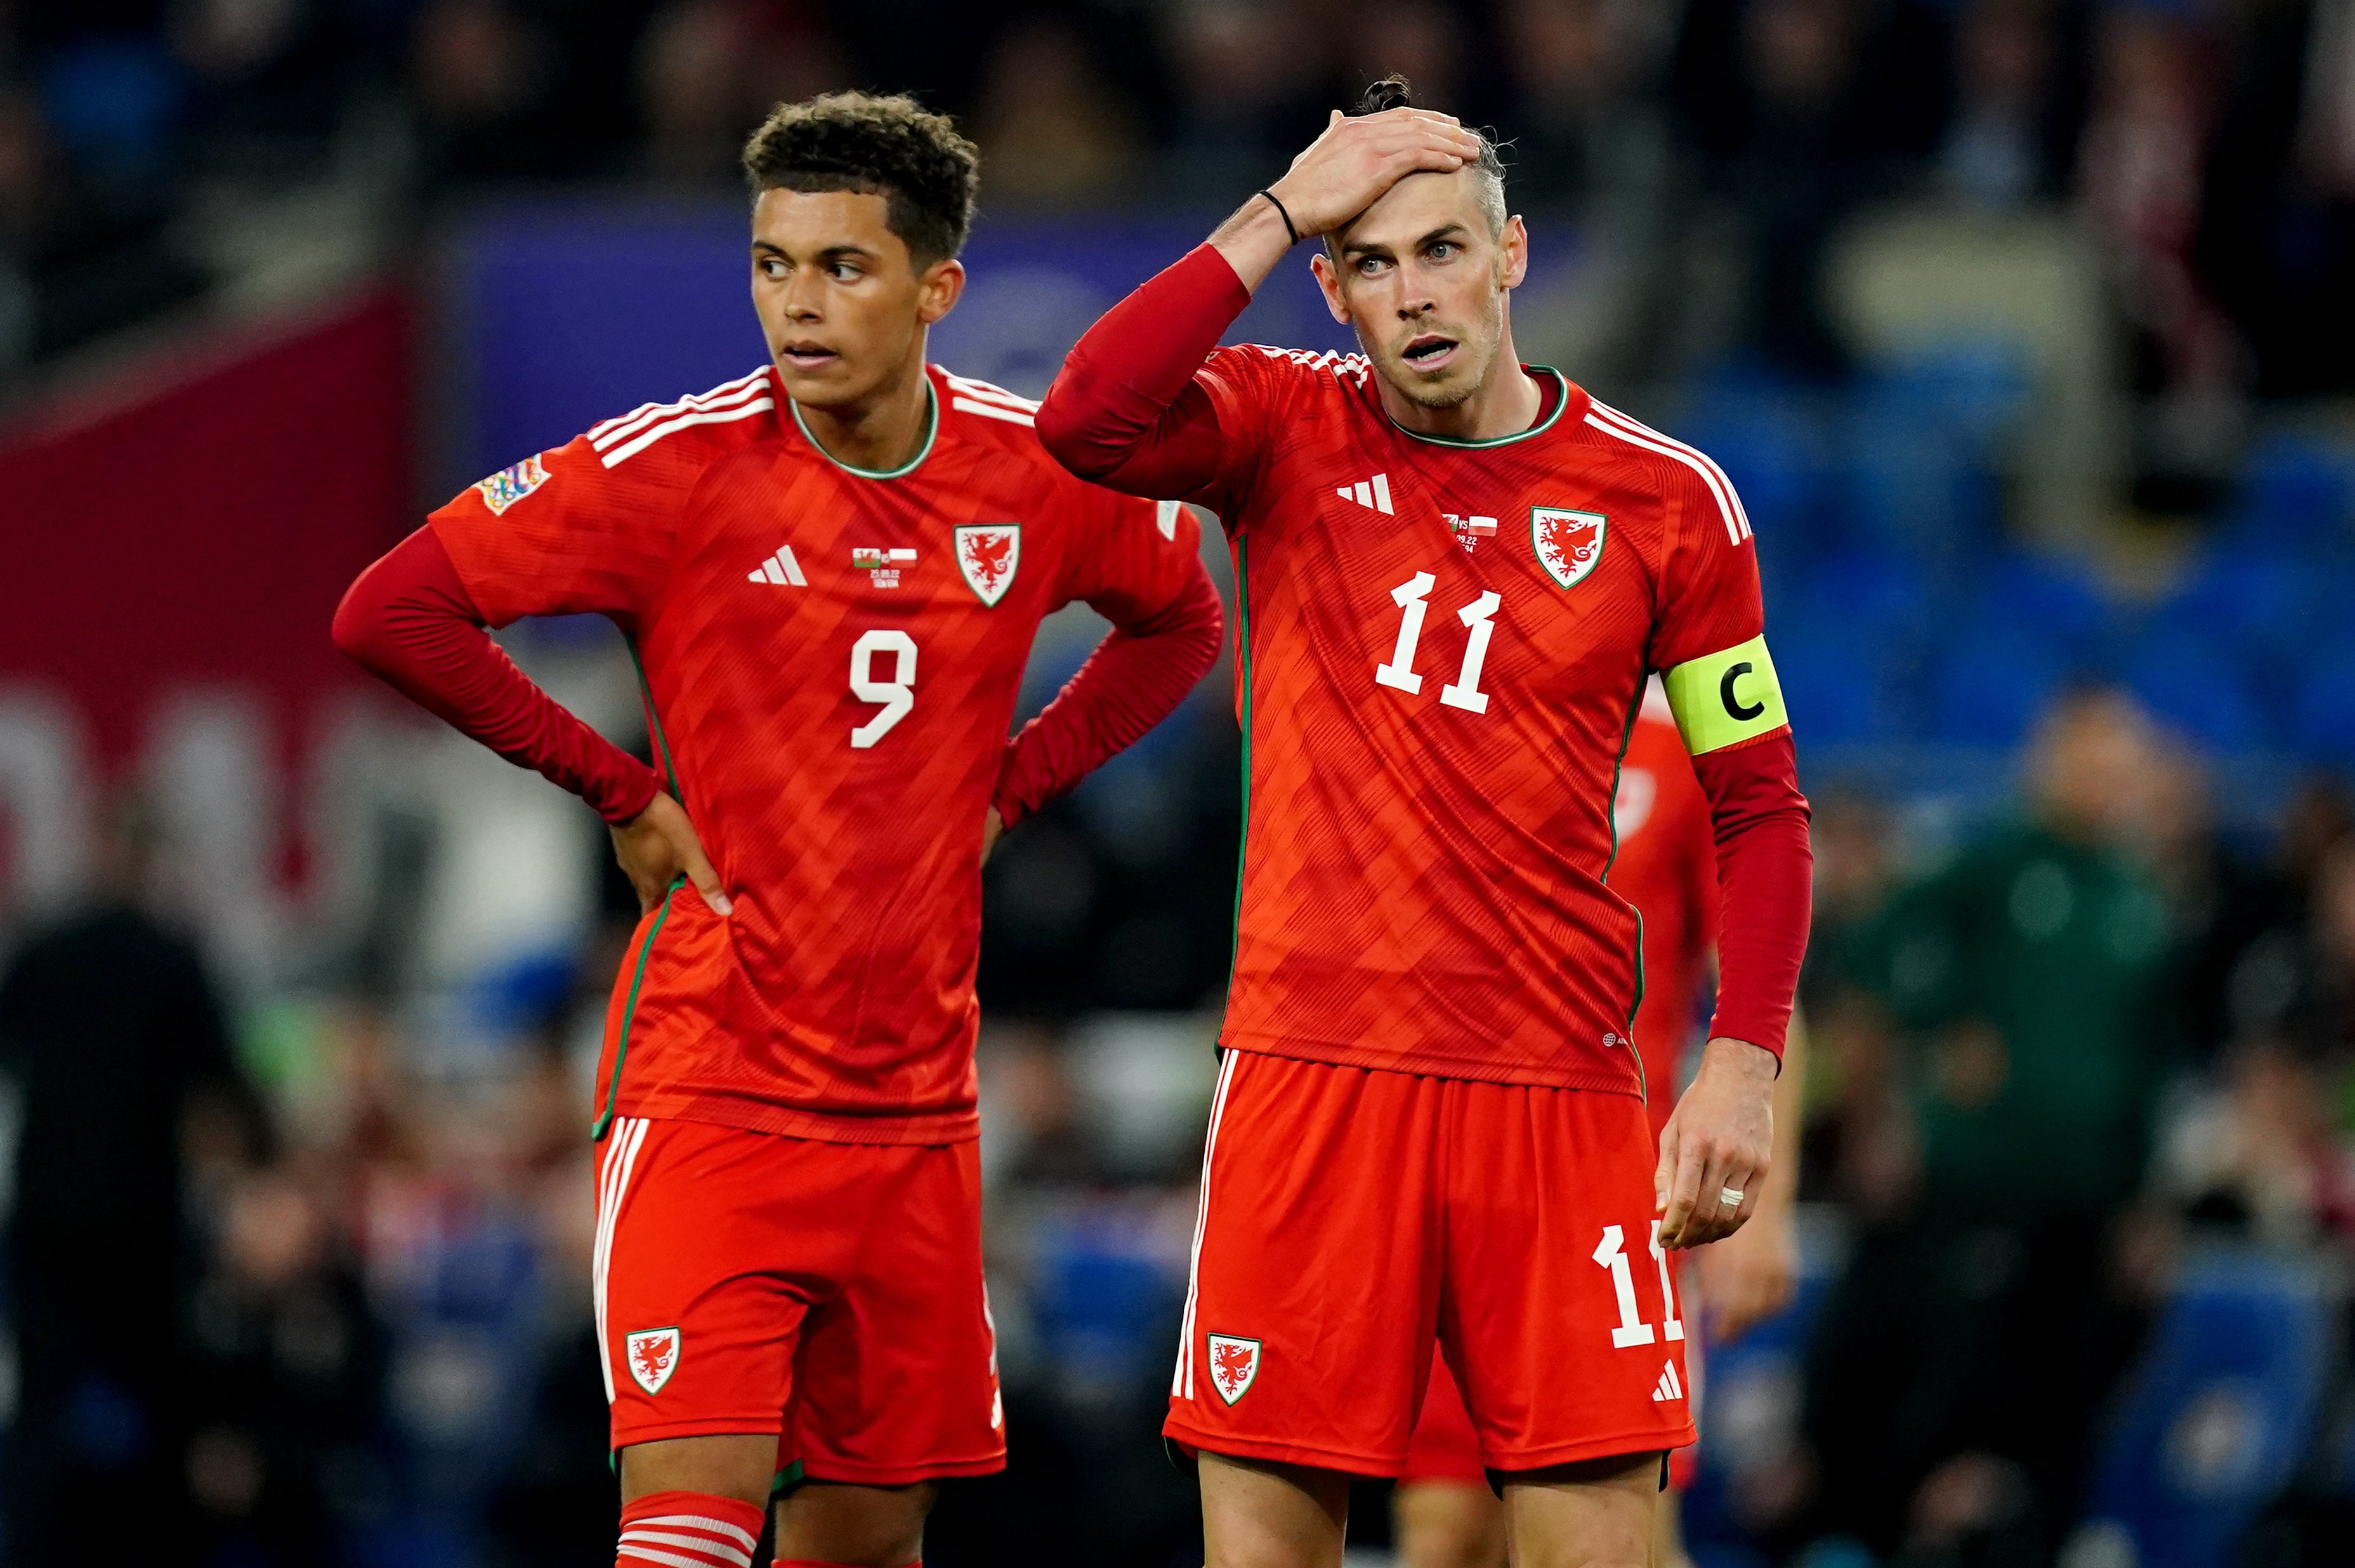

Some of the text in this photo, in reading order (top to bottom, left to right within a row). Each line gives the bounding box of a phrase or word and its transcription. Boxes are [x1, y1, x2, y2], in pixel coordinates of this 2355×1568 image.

[1459, 519, 1469, 529] VS
[850, 630, 917, 748] 9
[1376, 571, 1501, 714] 11
[1720, 662, 1765, 721] C
[1592, 1219, 1685, 1349] 11
